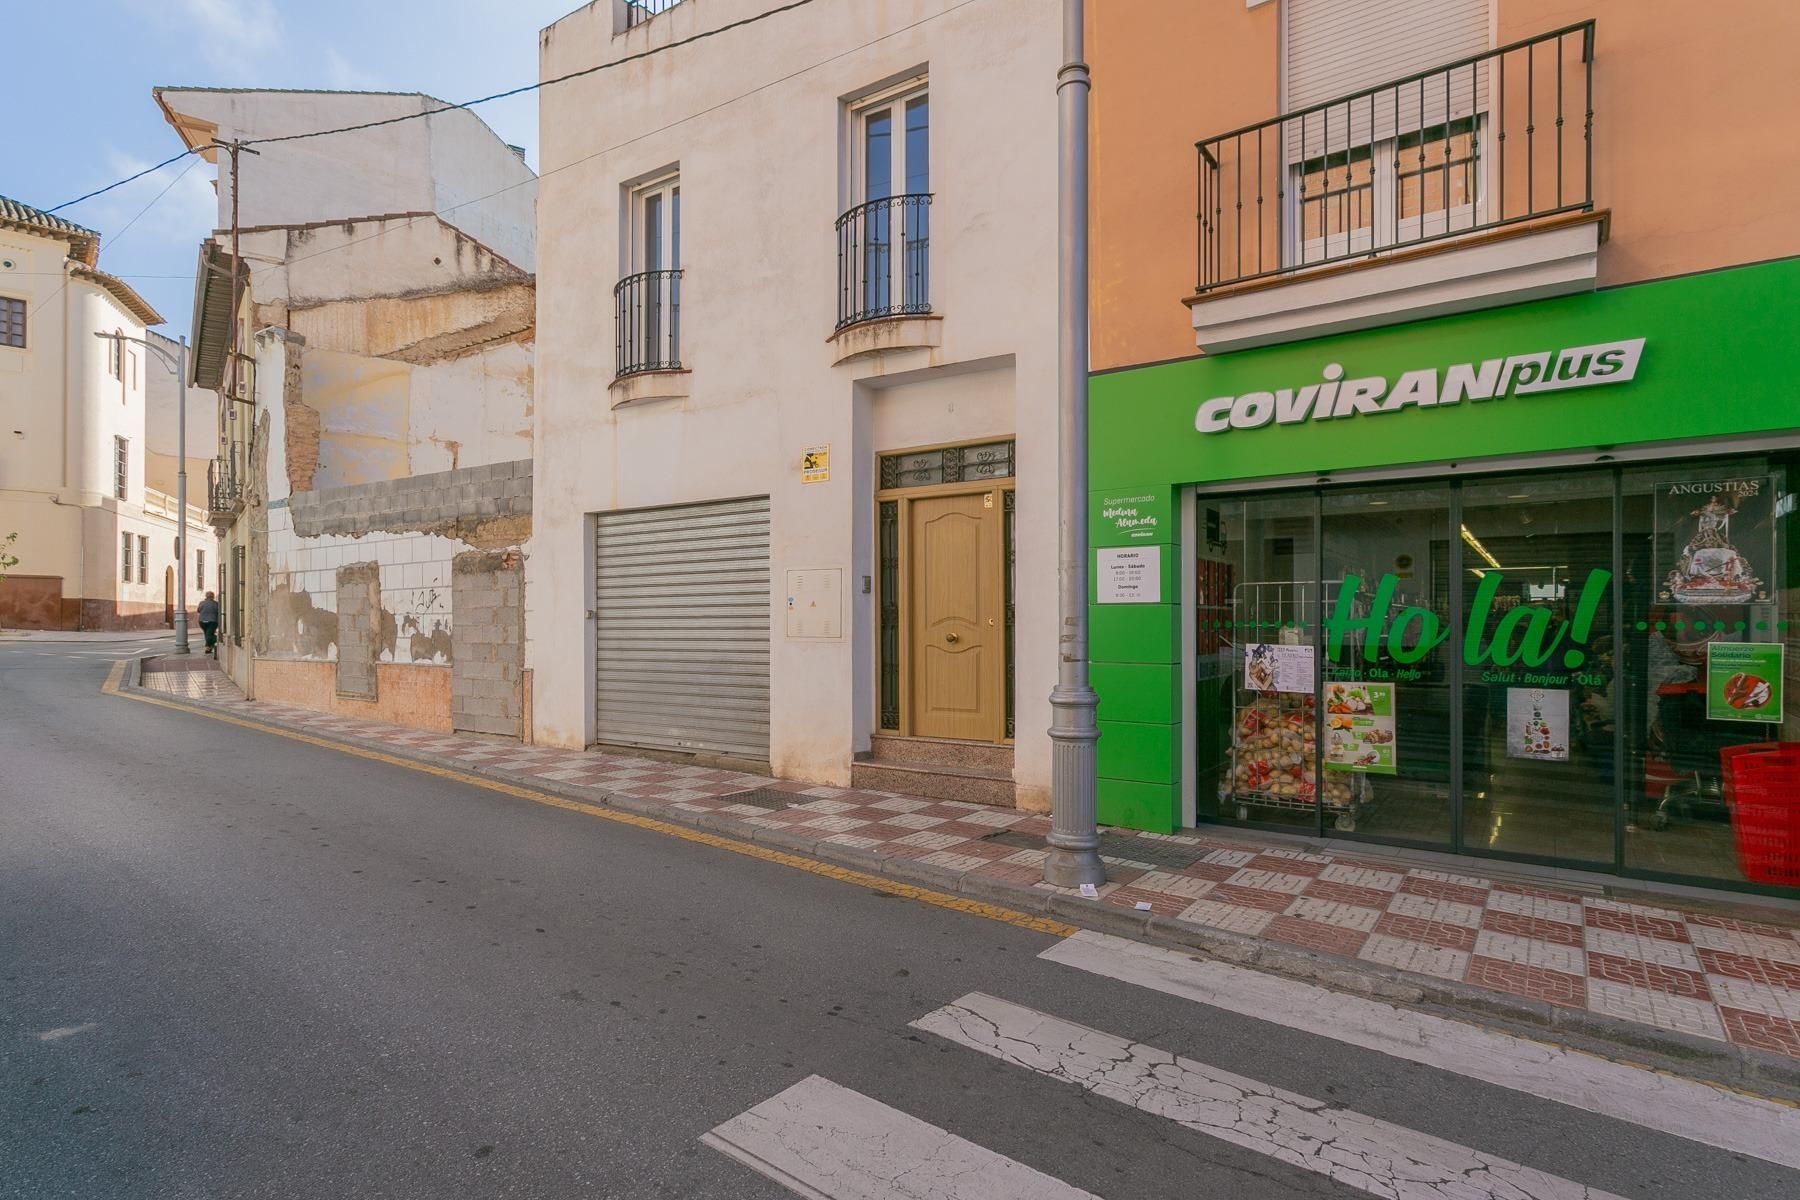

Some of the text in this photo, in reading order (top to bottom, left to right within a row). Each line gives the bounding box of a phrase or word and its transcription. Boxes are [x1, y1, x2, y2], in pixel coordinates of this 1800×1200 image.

[1505, 346, 1628, 396] plus
[1669, 480, 1760, 495] ANGUSTIAS
[1103, 495, 1155, 506] Supermercado
[1481, 671, 1515, 683] Salut
[1524, 672, 1569, 686] Bonjour
